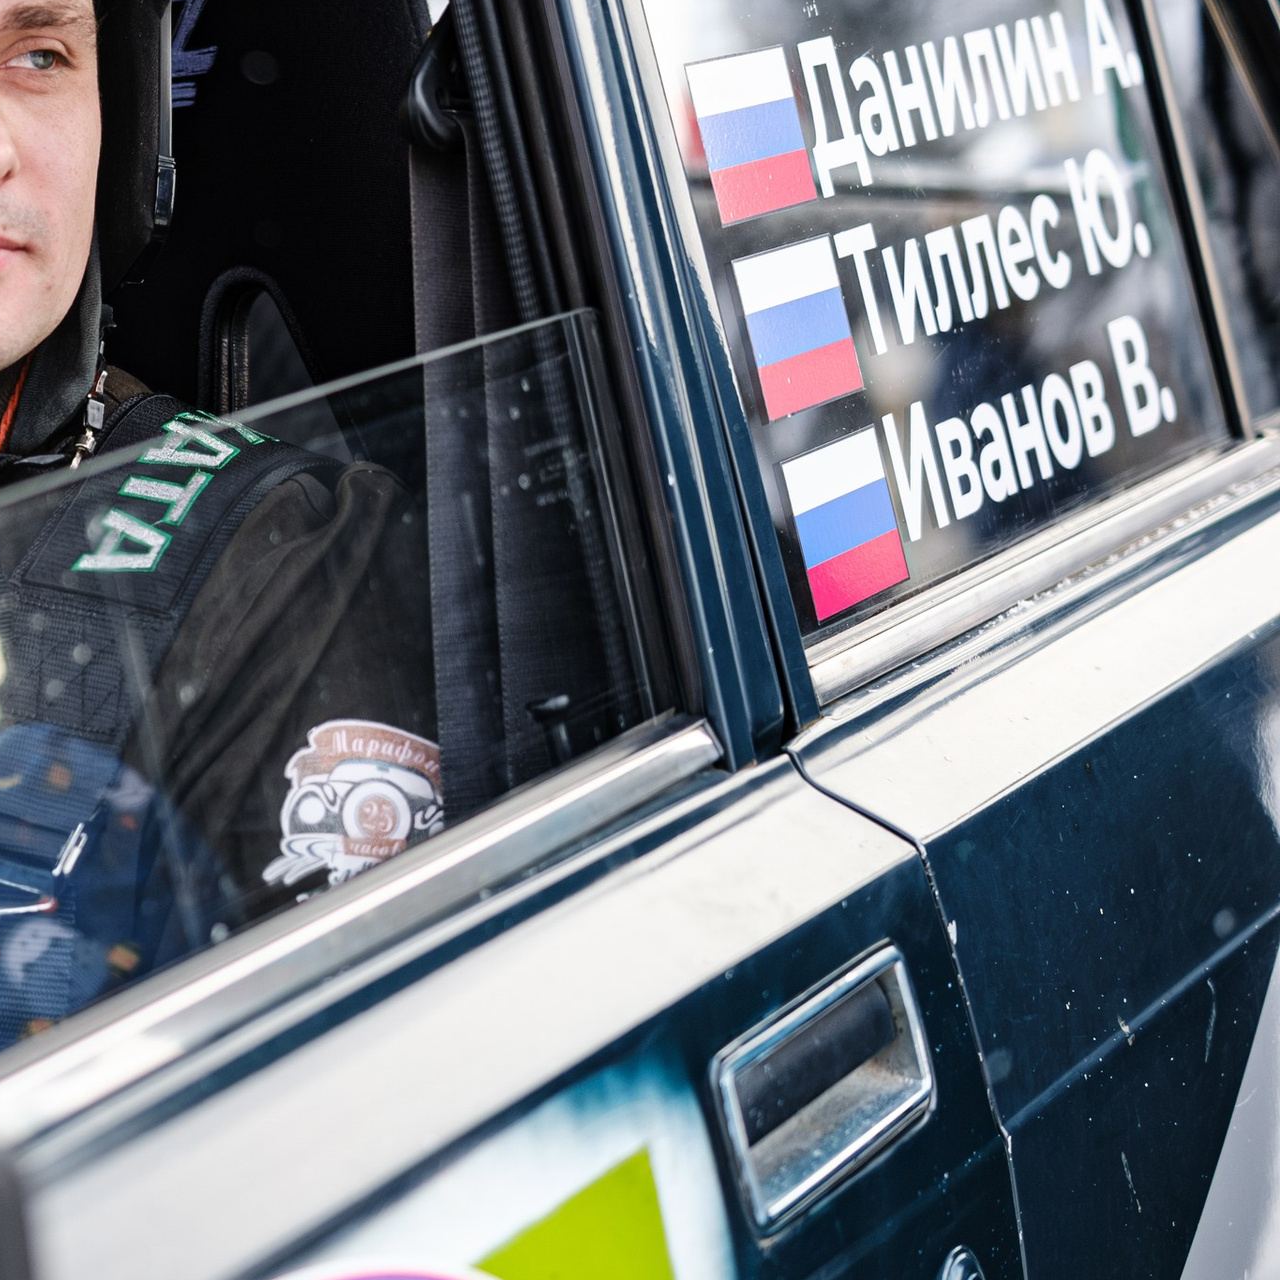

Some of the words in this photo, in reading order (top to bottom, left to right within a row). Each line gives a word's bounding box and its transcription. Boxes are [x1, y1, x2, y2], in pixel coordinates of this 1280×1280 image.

[796, 11, 1080, 198] Данилин
[833, 193, 1073, 356] Тиллес
[1064, 147, 1152, 276] Ю.
[881, 358, 1116, 543] Иванов
[1107, 314, 1178, 438] В.
[360, 801, 394, 833] 25
